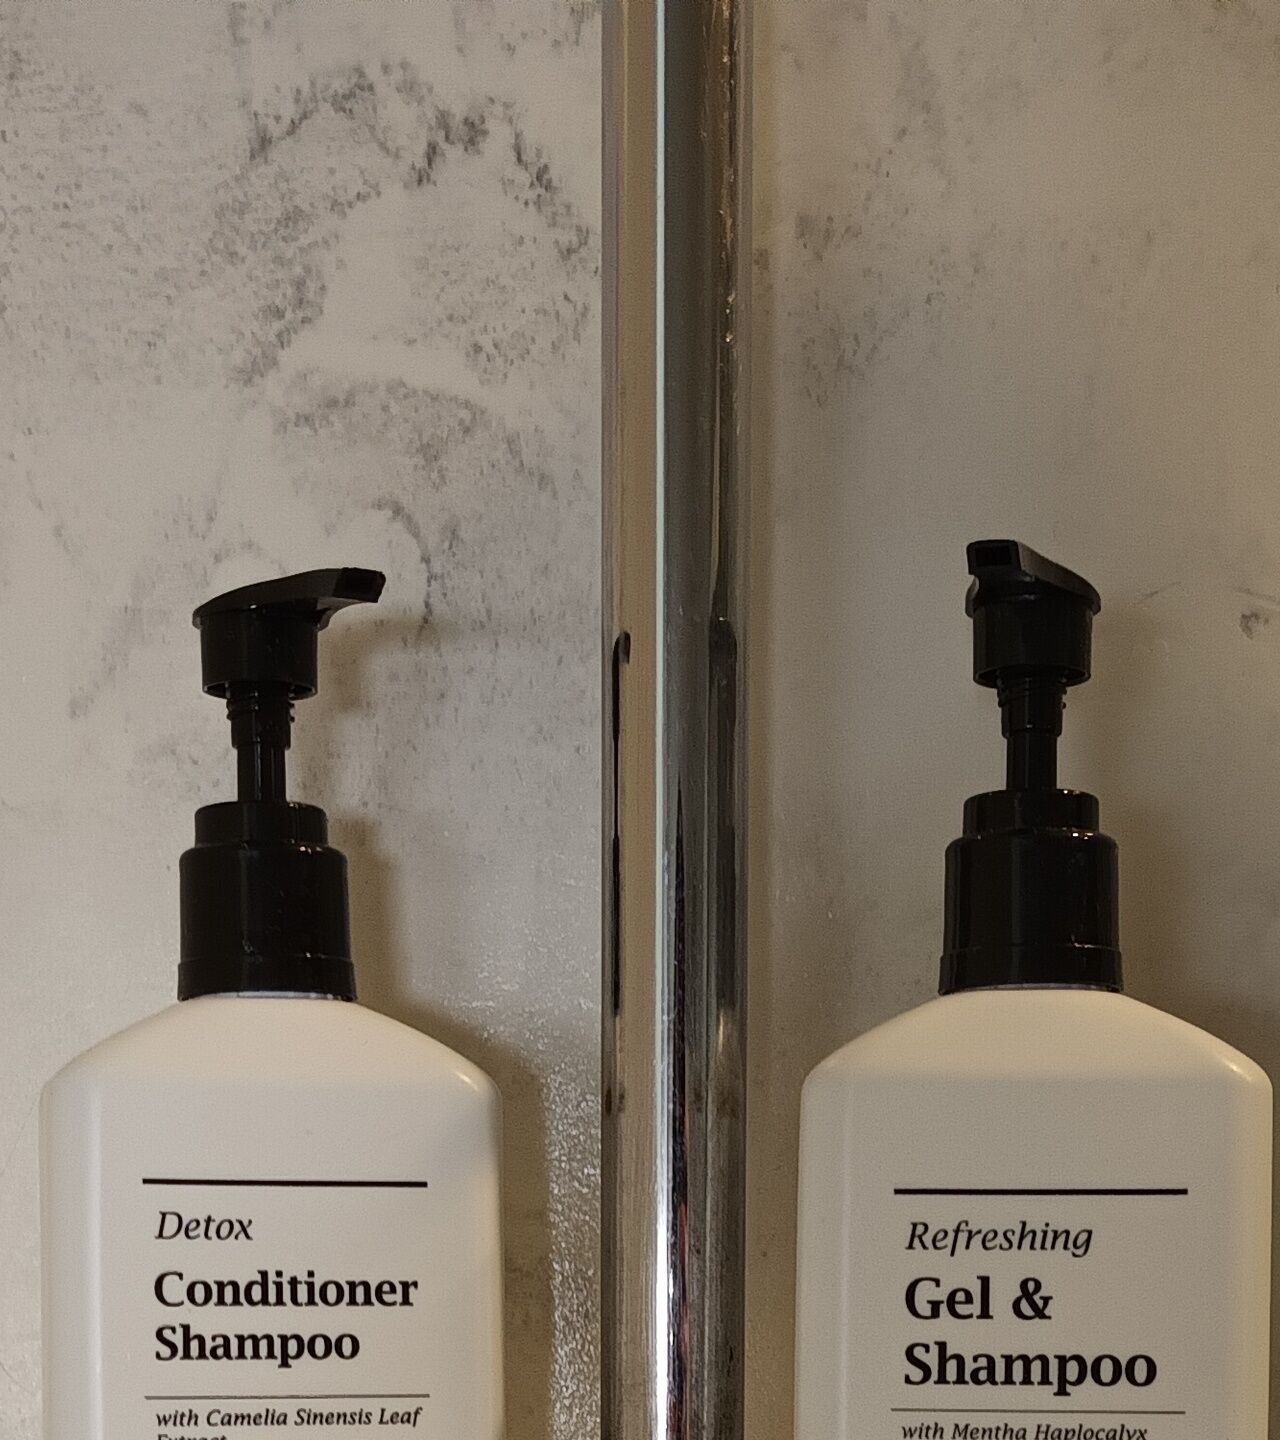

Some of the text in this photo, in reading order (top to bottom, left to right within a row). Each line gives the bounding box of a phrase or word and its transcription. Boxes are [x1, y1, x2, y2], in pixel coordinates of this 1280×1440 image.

[155, 1211, 253, 1240] Detox
[905, 1220, 1093, 1258] Refreshing
[154, 1270, 418, 1307] Conditioner
[905, 1275, 1053, 1321] Gel &
[155, 1323, 360, 1368] Shampoo
[904, 1341, 1157, 1397] Shampoo
[156, 1407, 423, 1427] with Camelia Sinensis Leaf
[902, 1422, 944, 1440] with
[951, 1423, 1027, 1440] Mentha
